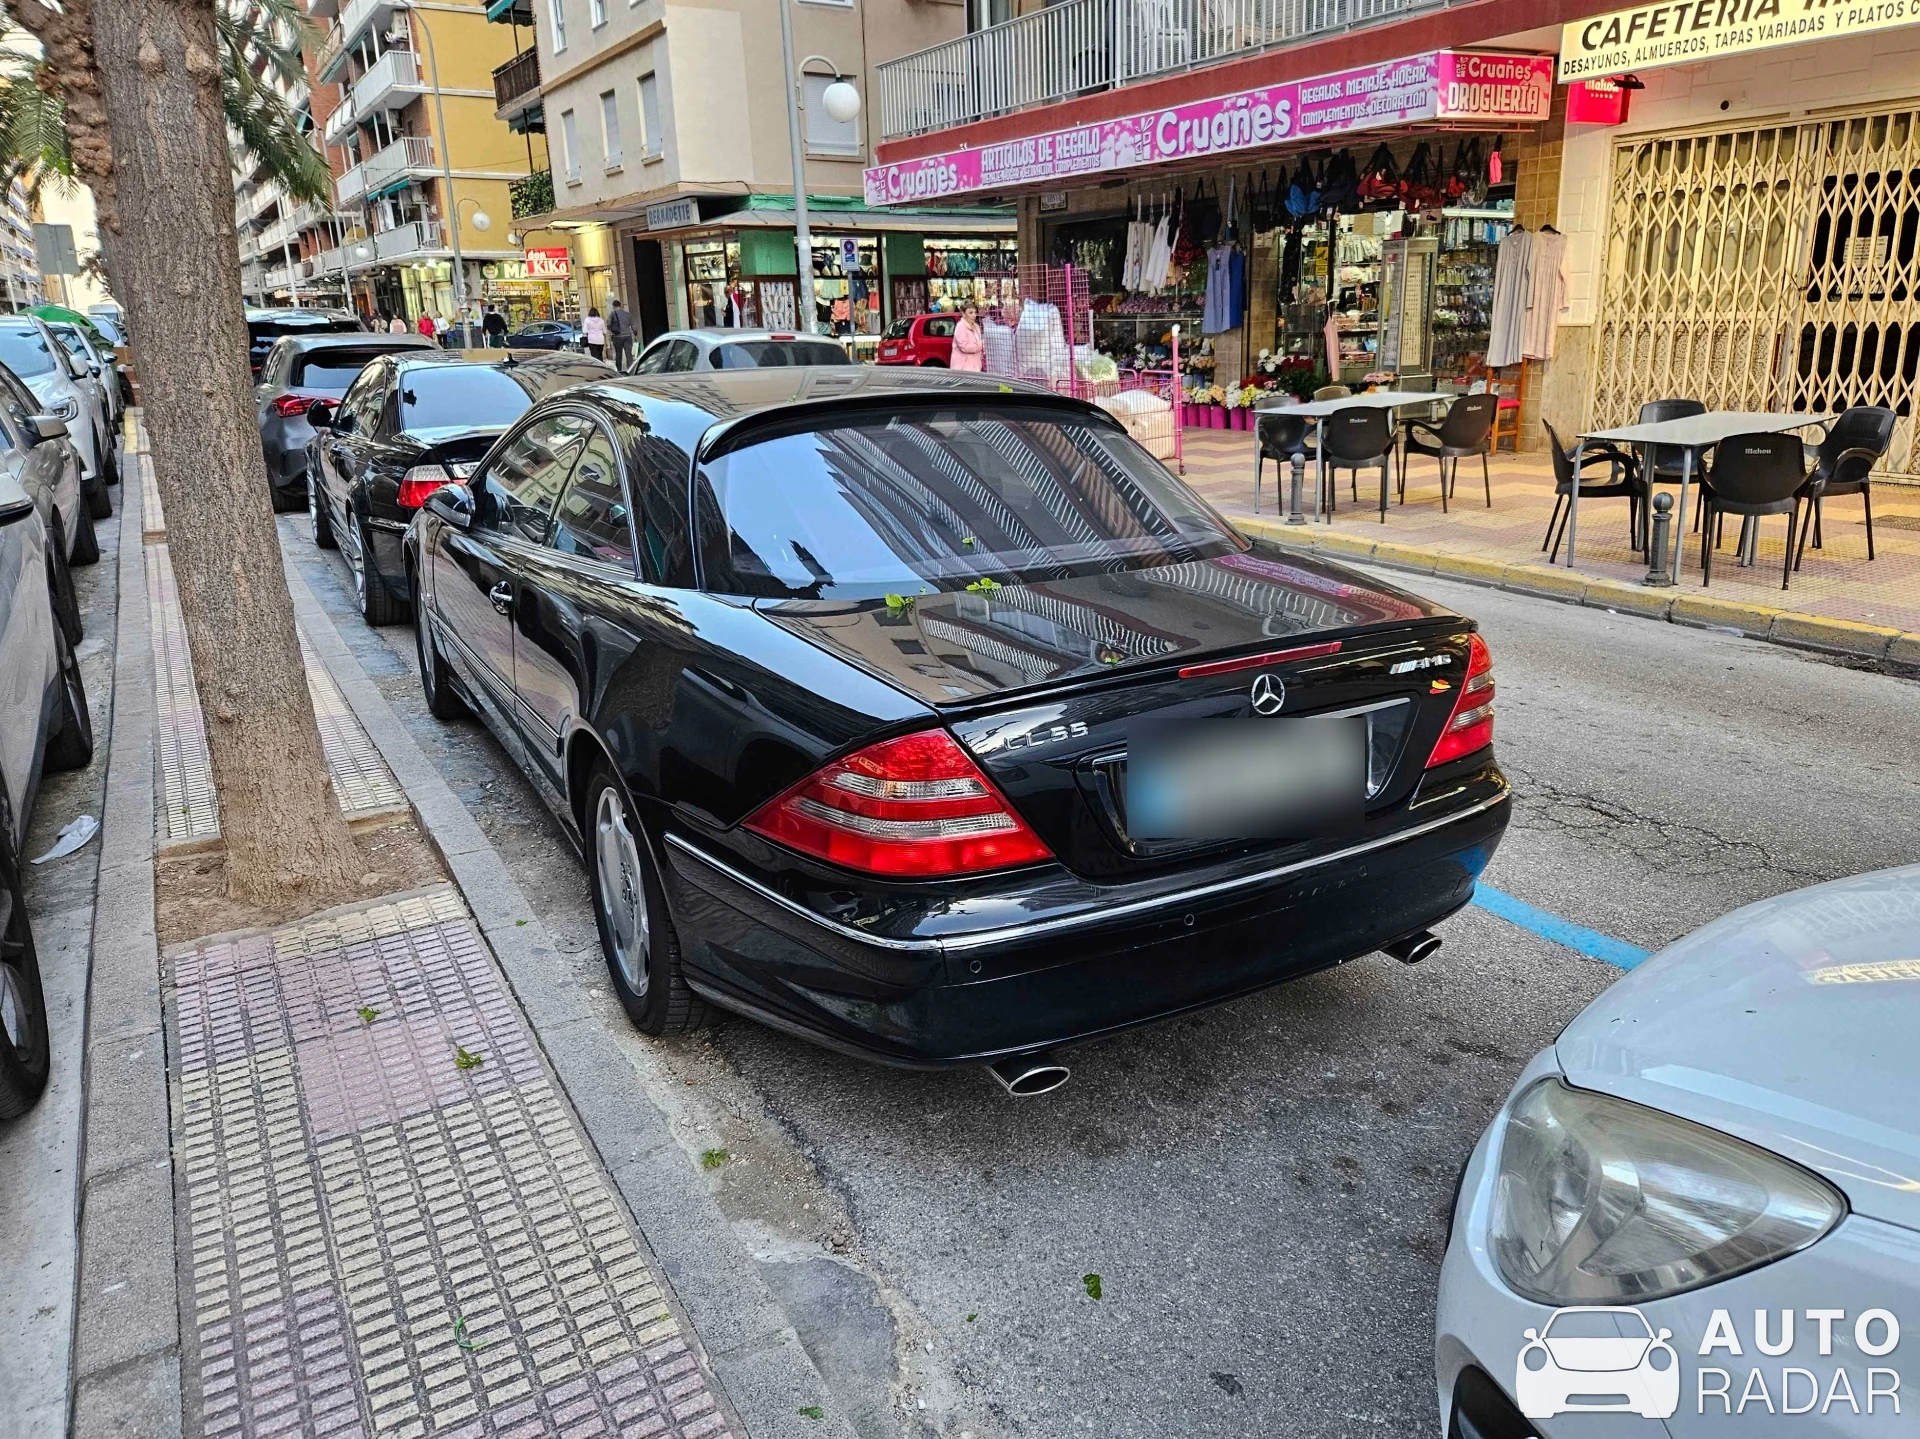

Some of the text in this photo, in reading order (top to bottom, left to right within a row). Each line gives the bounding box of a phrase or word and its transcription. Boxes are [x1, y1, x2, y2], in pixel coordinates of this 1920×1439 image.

[1563, 53, 1631, 76] DESAYUNOS,
[1635, 36, 1710, 63] ALMUERZOS,
[1715, 27, 1753, 48] TAPAS
[1758, 15, 1825, 41] VARIADAS
[1835, 11, 1844, 28] Y
[1848, 2, 1905, 26] PLATOS
[1468, 57, 1532, 81] Cruañes
[1585, 78, 1619, 92] Mahou
[1301, 82, 1344, 105] REGALOS,
[1346, 72, 1390, 96] MENAJE,
[1448, 81, 1539, 114] DROGUERÍA
[1156, 97, 1291, 155] Cruañes
[1039, 138, 1053, 163] DE
[1056, 128, 1100, 159] REGALO
[888, 160, 957, 198] Cruañes
[1744, 447, 1772, 455] Mahou
